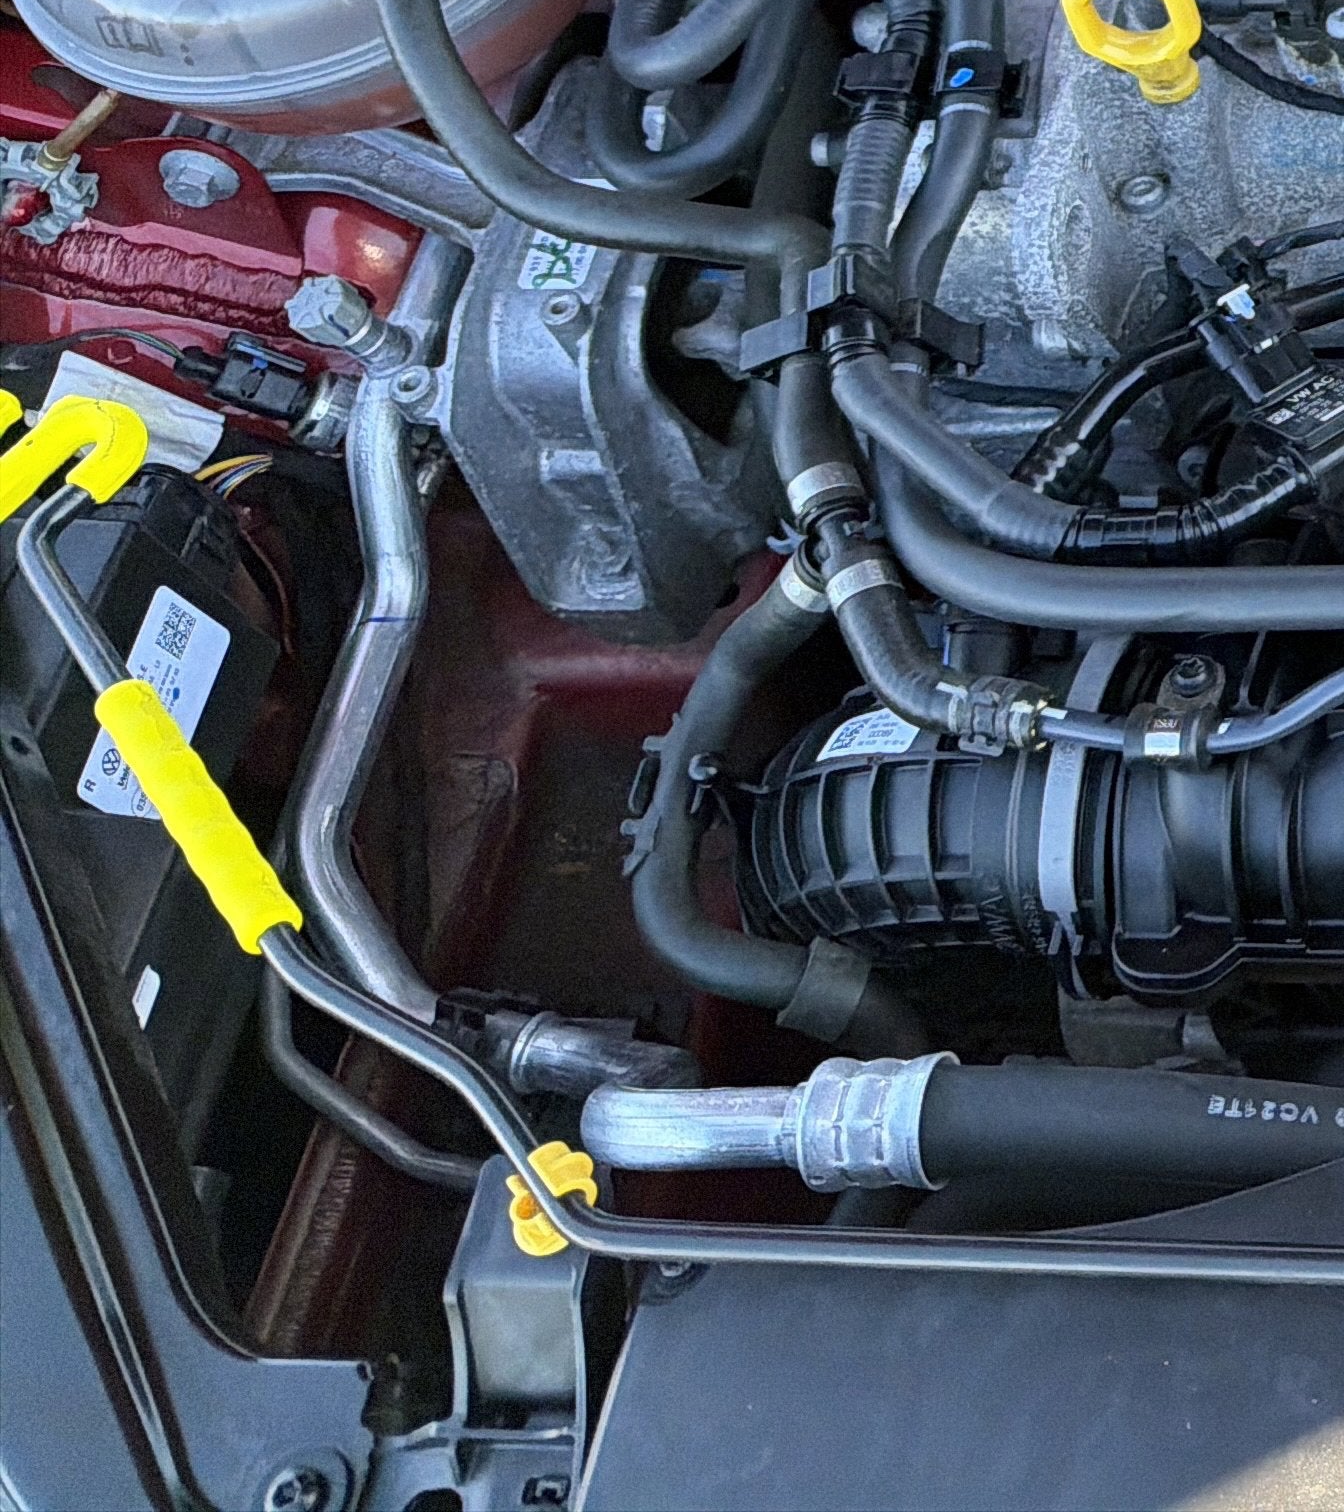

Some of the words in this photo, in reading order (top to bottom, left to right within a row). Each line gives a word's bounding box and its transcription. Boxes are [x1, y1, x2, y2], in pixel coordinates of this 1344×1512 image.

[1286, 386, 1312, 404] VW
[1313, 375, 1335, 391] AG
[83, 777, 97, 794] R
